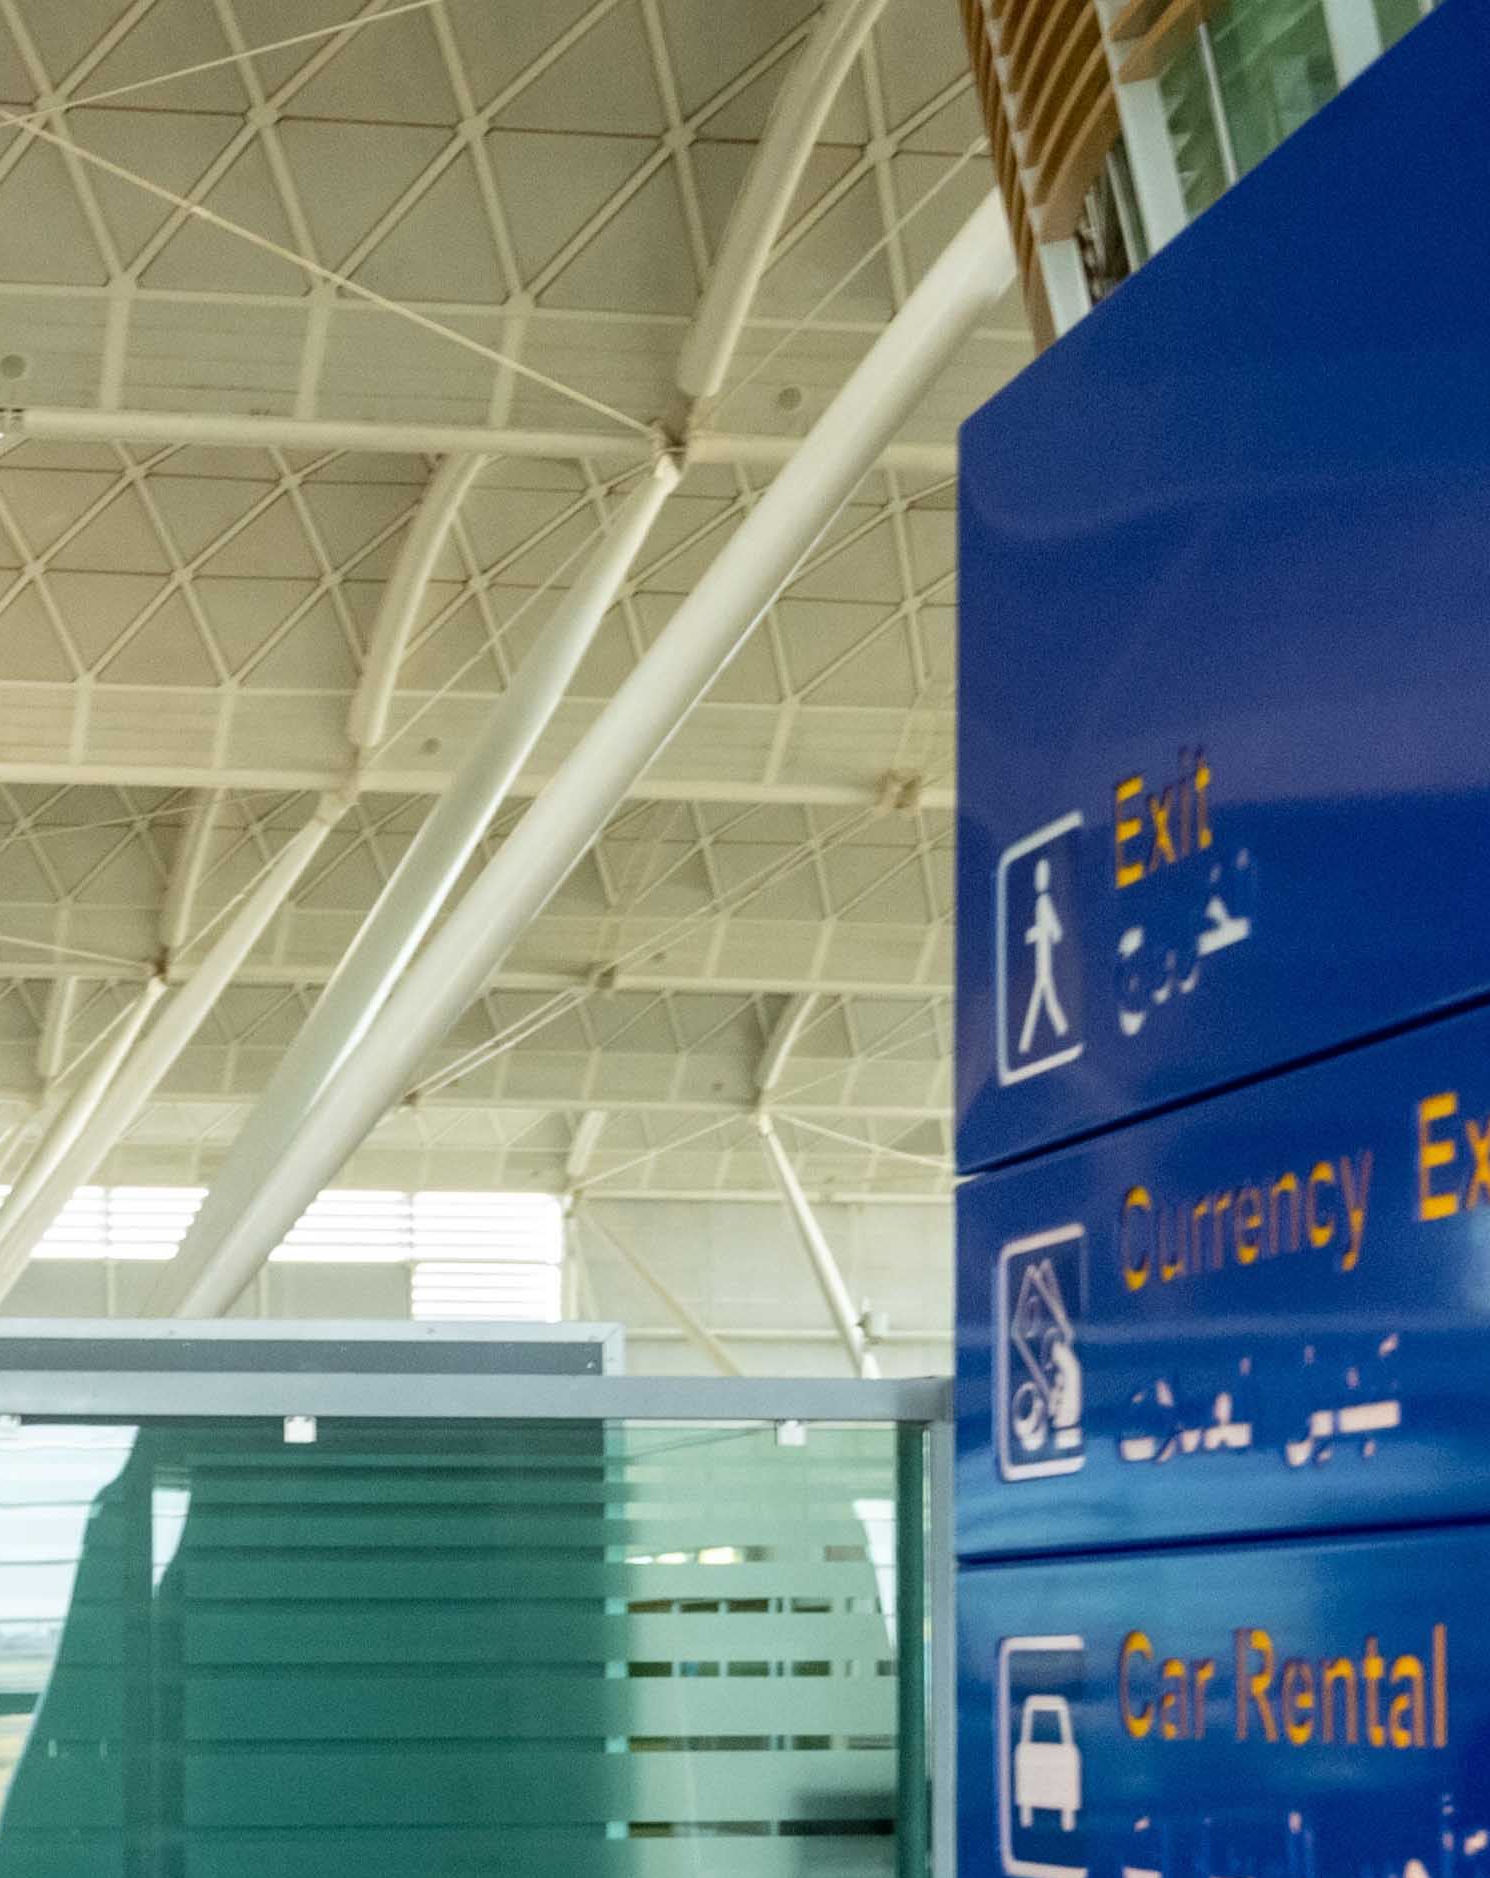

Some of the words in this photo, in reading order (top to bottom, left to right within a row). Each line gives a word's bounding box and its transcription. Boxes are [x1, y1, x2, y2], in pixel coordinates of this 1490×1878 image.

[1114, 745, 1212, 889] Exit
[1120, 1149, 1374, 1292] Currency
[1118, 1628, 1216, 1741] Car
[1232, 1620, 1449, 1749] Rental
